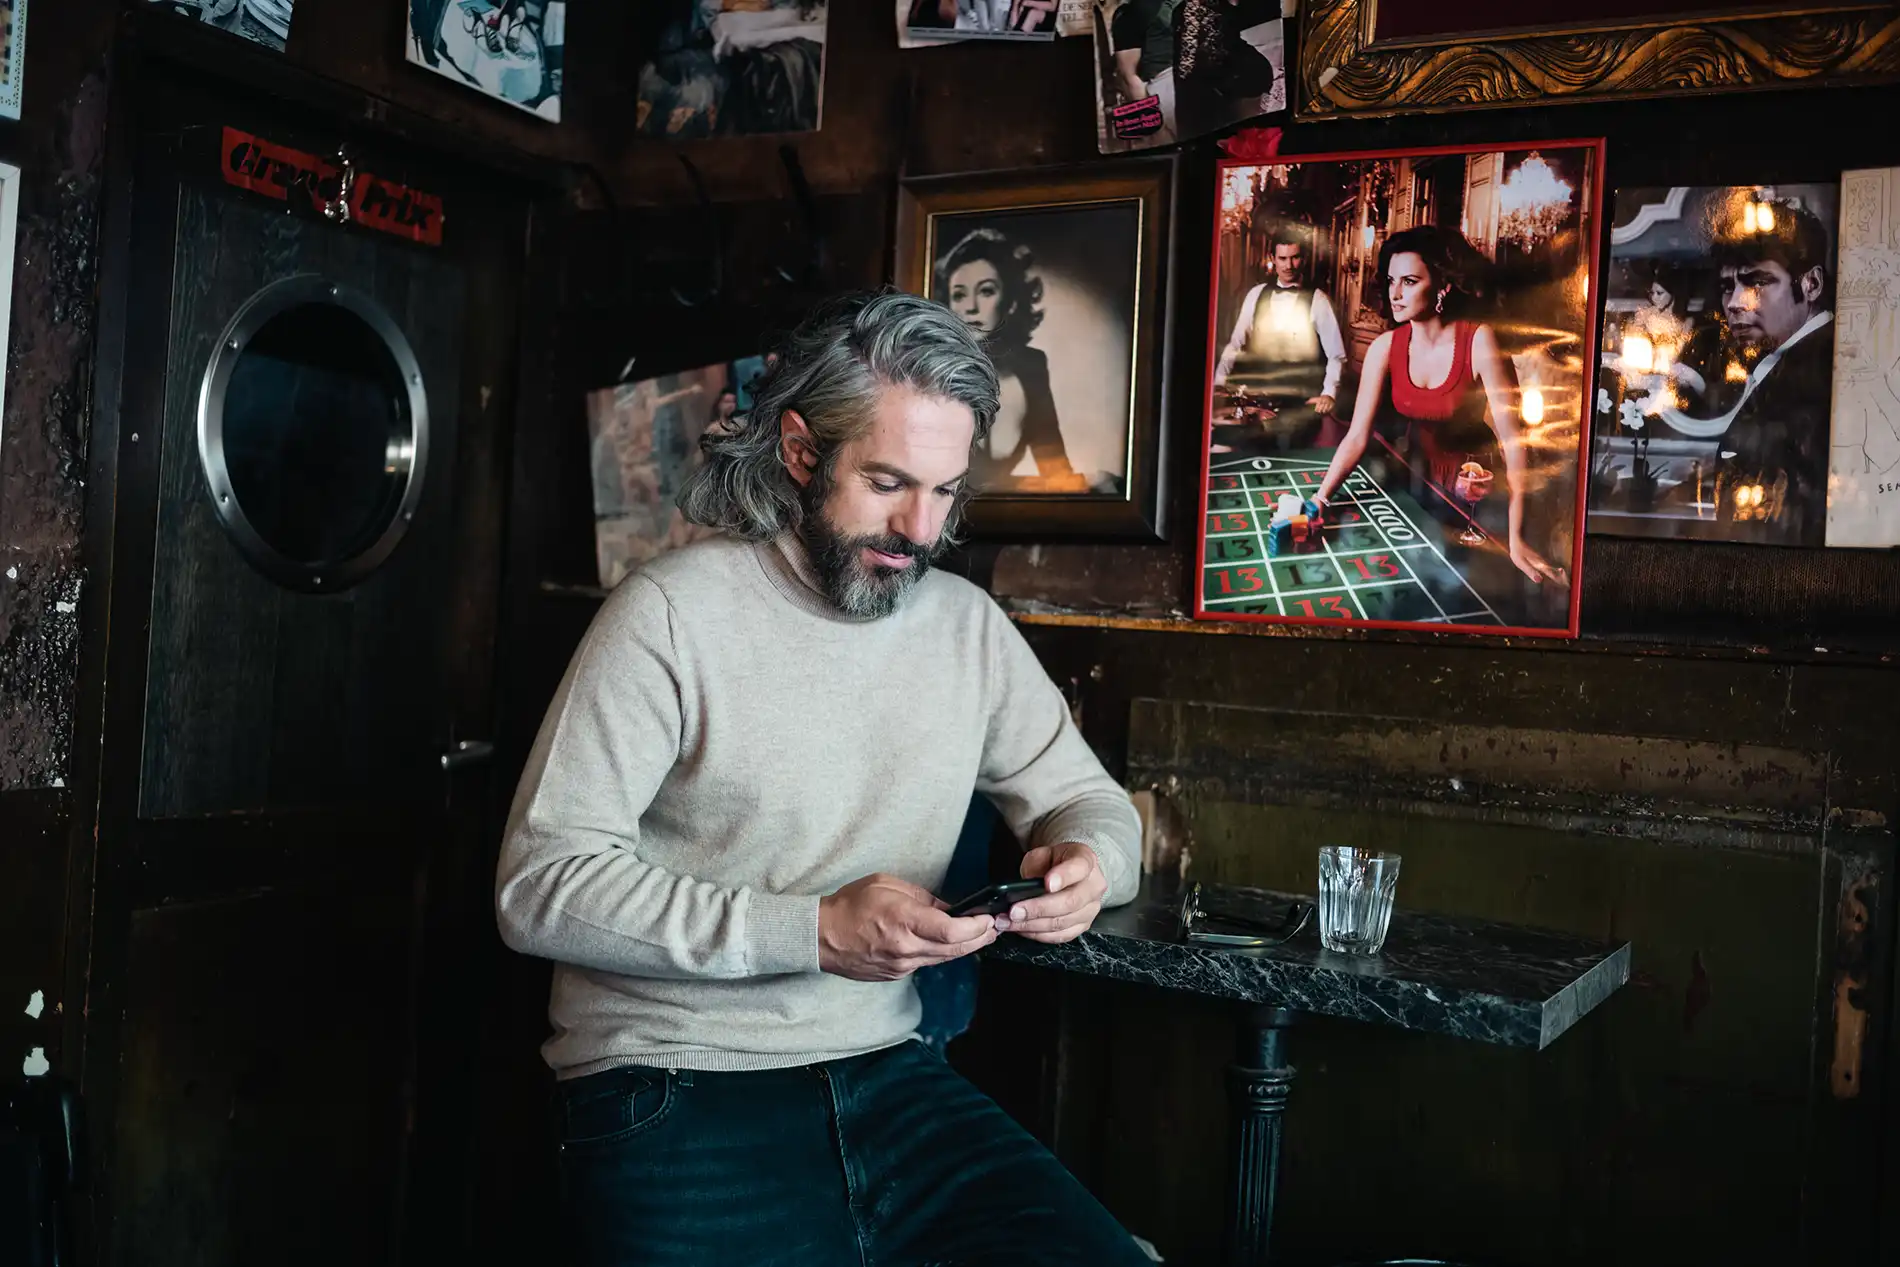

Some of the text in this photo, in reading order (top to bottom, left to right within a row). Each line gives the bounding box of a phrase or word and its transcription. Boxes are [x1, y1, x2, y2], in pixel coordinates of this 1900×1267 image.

[361, 180, 433, 230] Prix
[1210, 513, 1249, 531] 13
[1368, 504, 1414, 541] ODD
[1211, 538, 1255, 559] 13
[1212, 555, 1400, 594] 13 13 13
[1292, 595, 1353, 620] 13
